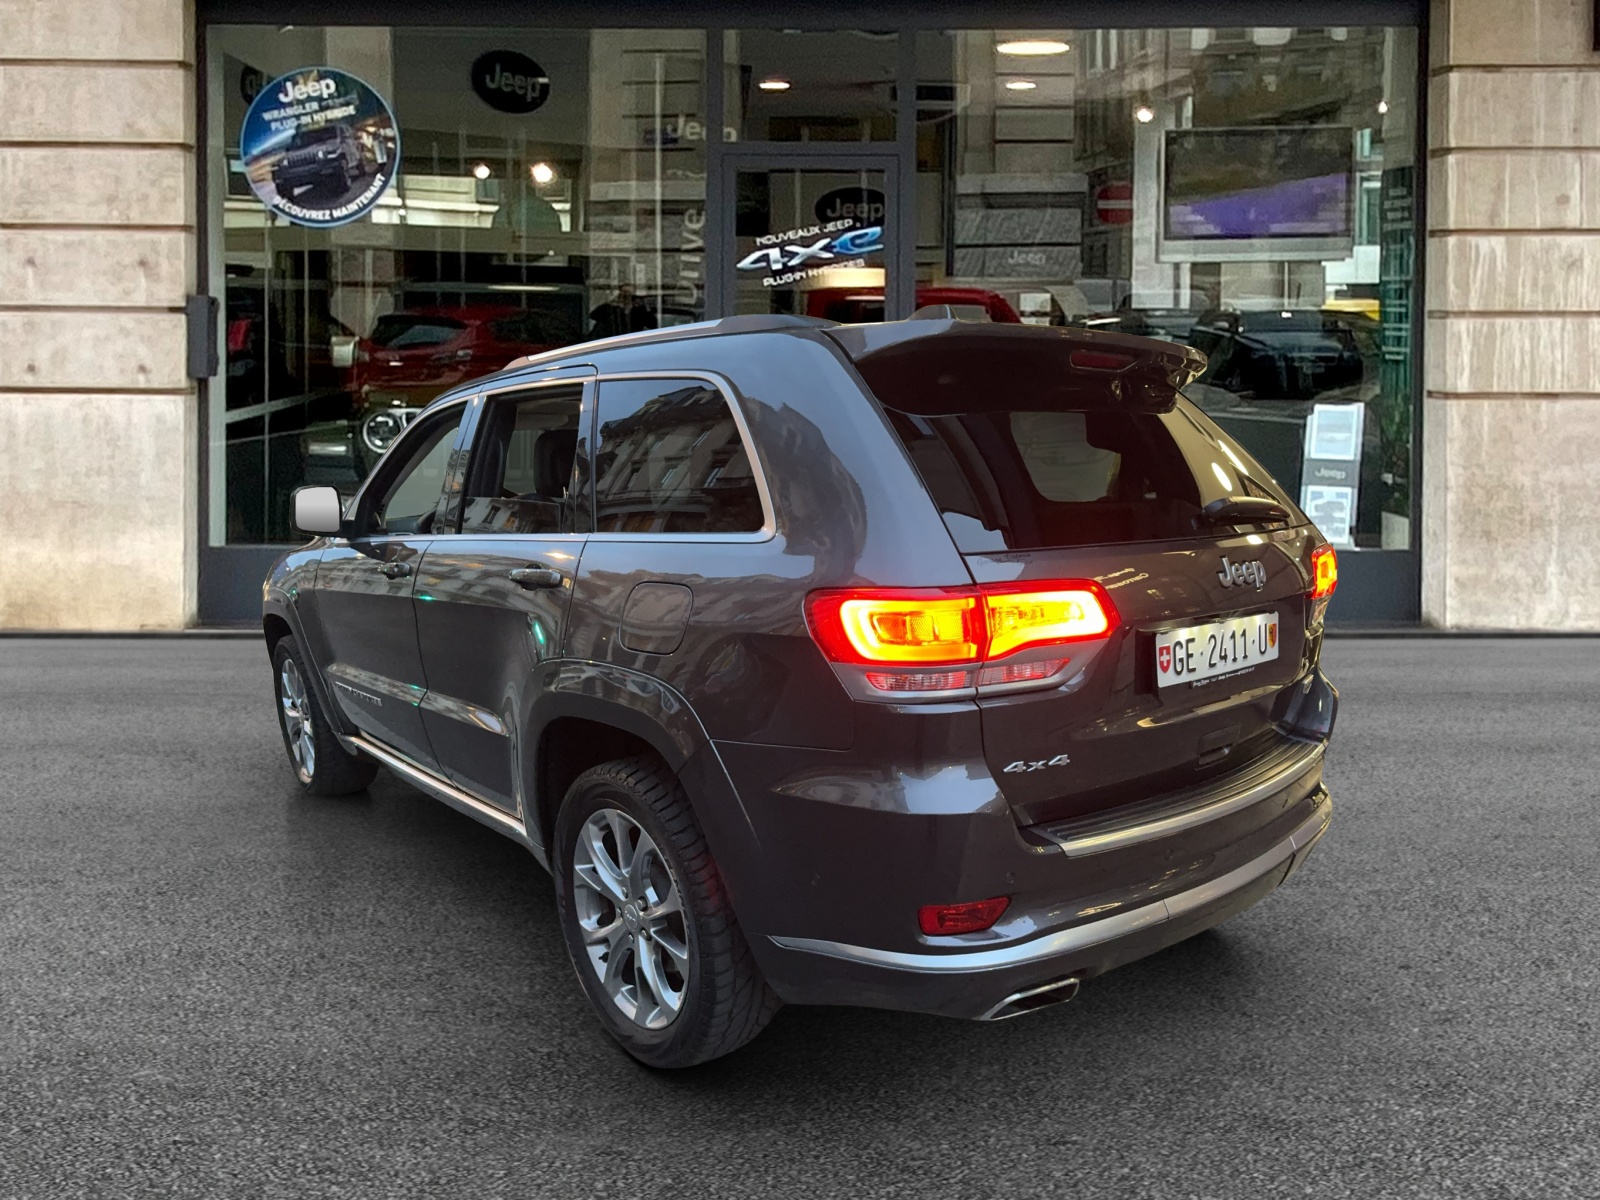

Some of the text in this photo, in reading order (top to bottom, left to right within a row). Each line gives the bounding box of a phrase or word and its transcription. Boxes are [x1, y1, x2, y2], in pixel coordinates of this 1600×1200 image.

[278, 78, 337, 103] Jeep
[485, 63, 541, 101] Jeep
[262, 102, 319, 121] WRANGLER
[667, 114, 737, 142] Jep
[332, 173, 386, 218] MAINTENANT
[827, 197, 884, 225] Jeep
[756, 219, 853, 246] NOUVEAUX JEEP
[1315, 467, 1346, 480] Jeep
[1216, 555, 1266, 592] Jeep
[1003, 754, 1070, 773] 4x4
